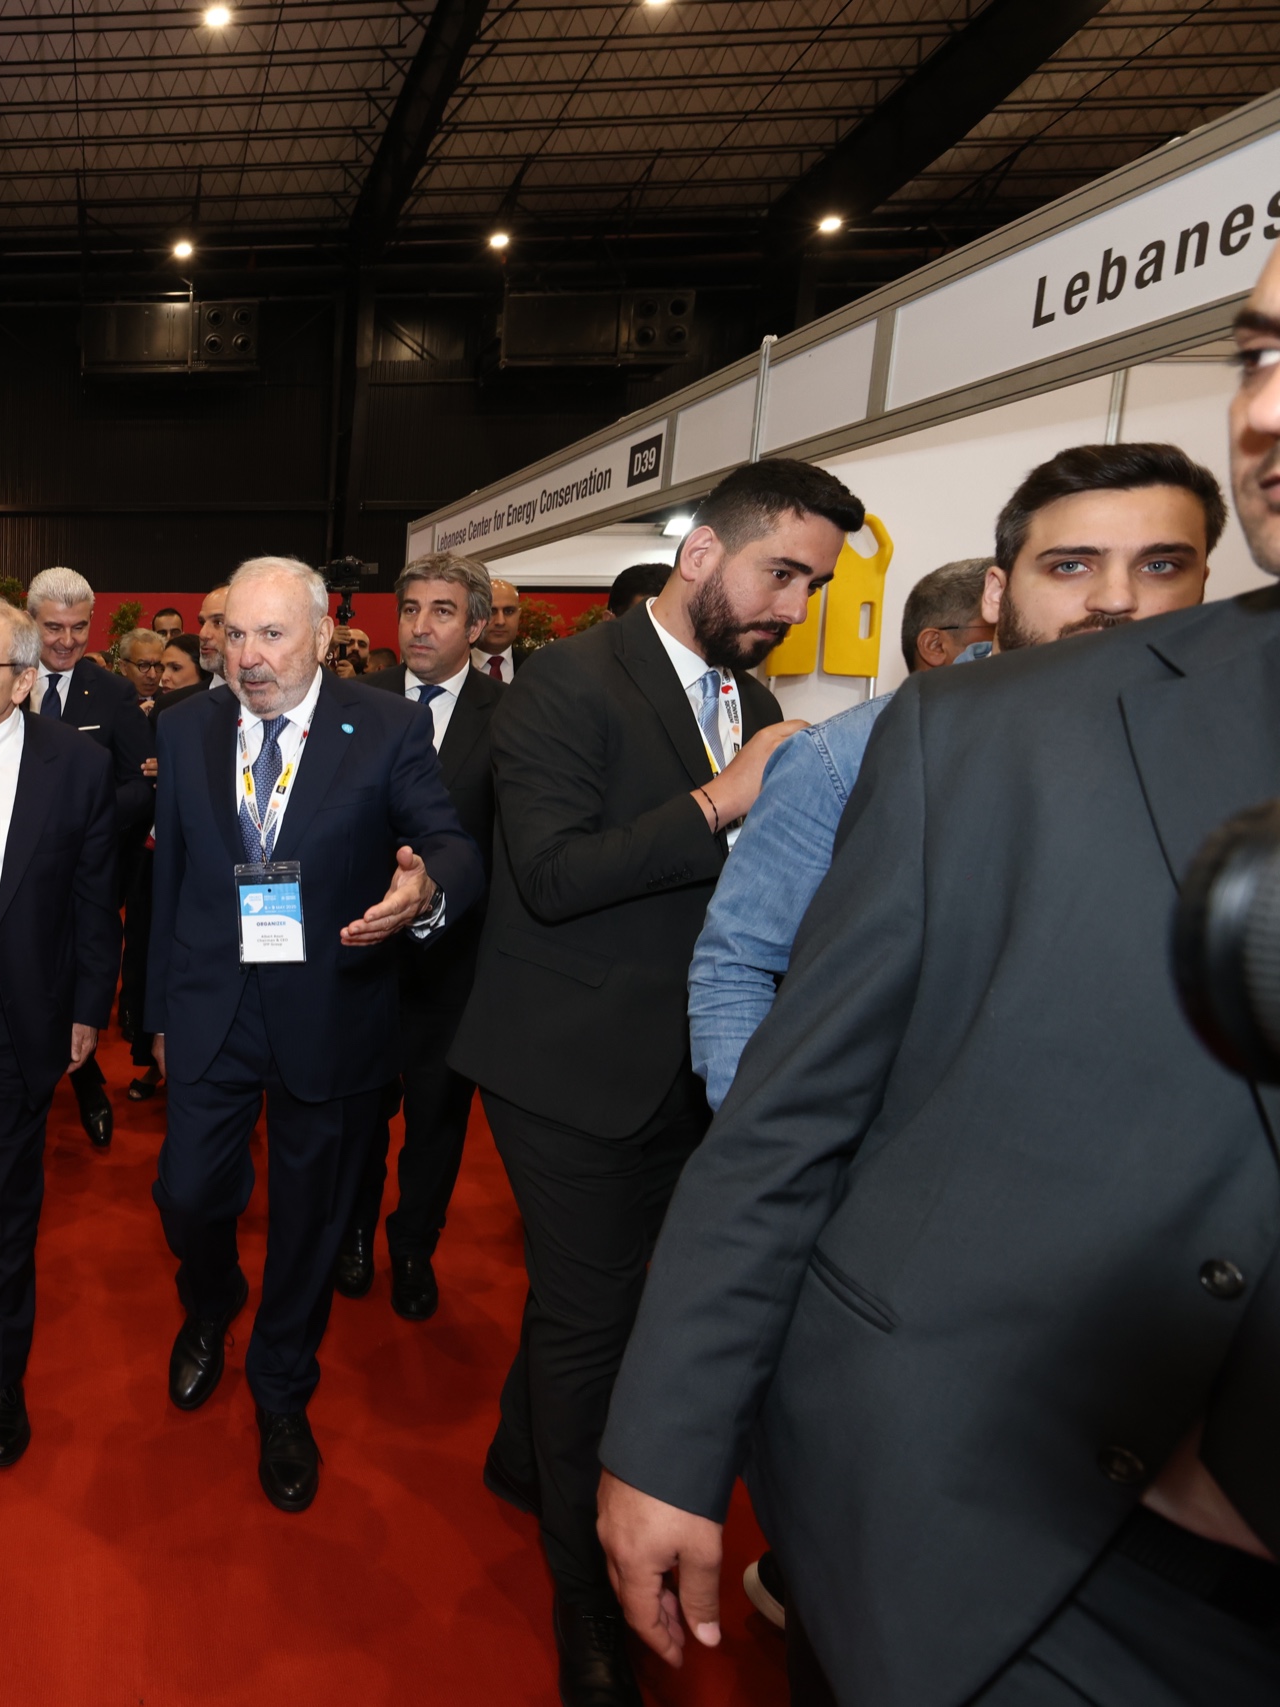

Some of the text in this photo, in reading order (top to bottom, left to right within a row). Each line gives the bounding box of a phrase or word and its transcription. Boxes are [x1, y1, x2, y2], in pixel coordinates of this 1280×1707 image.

[633, 446, 657, 477] D39
[436, 467, 612, 552] Lebanese Center for Energy Conservation
